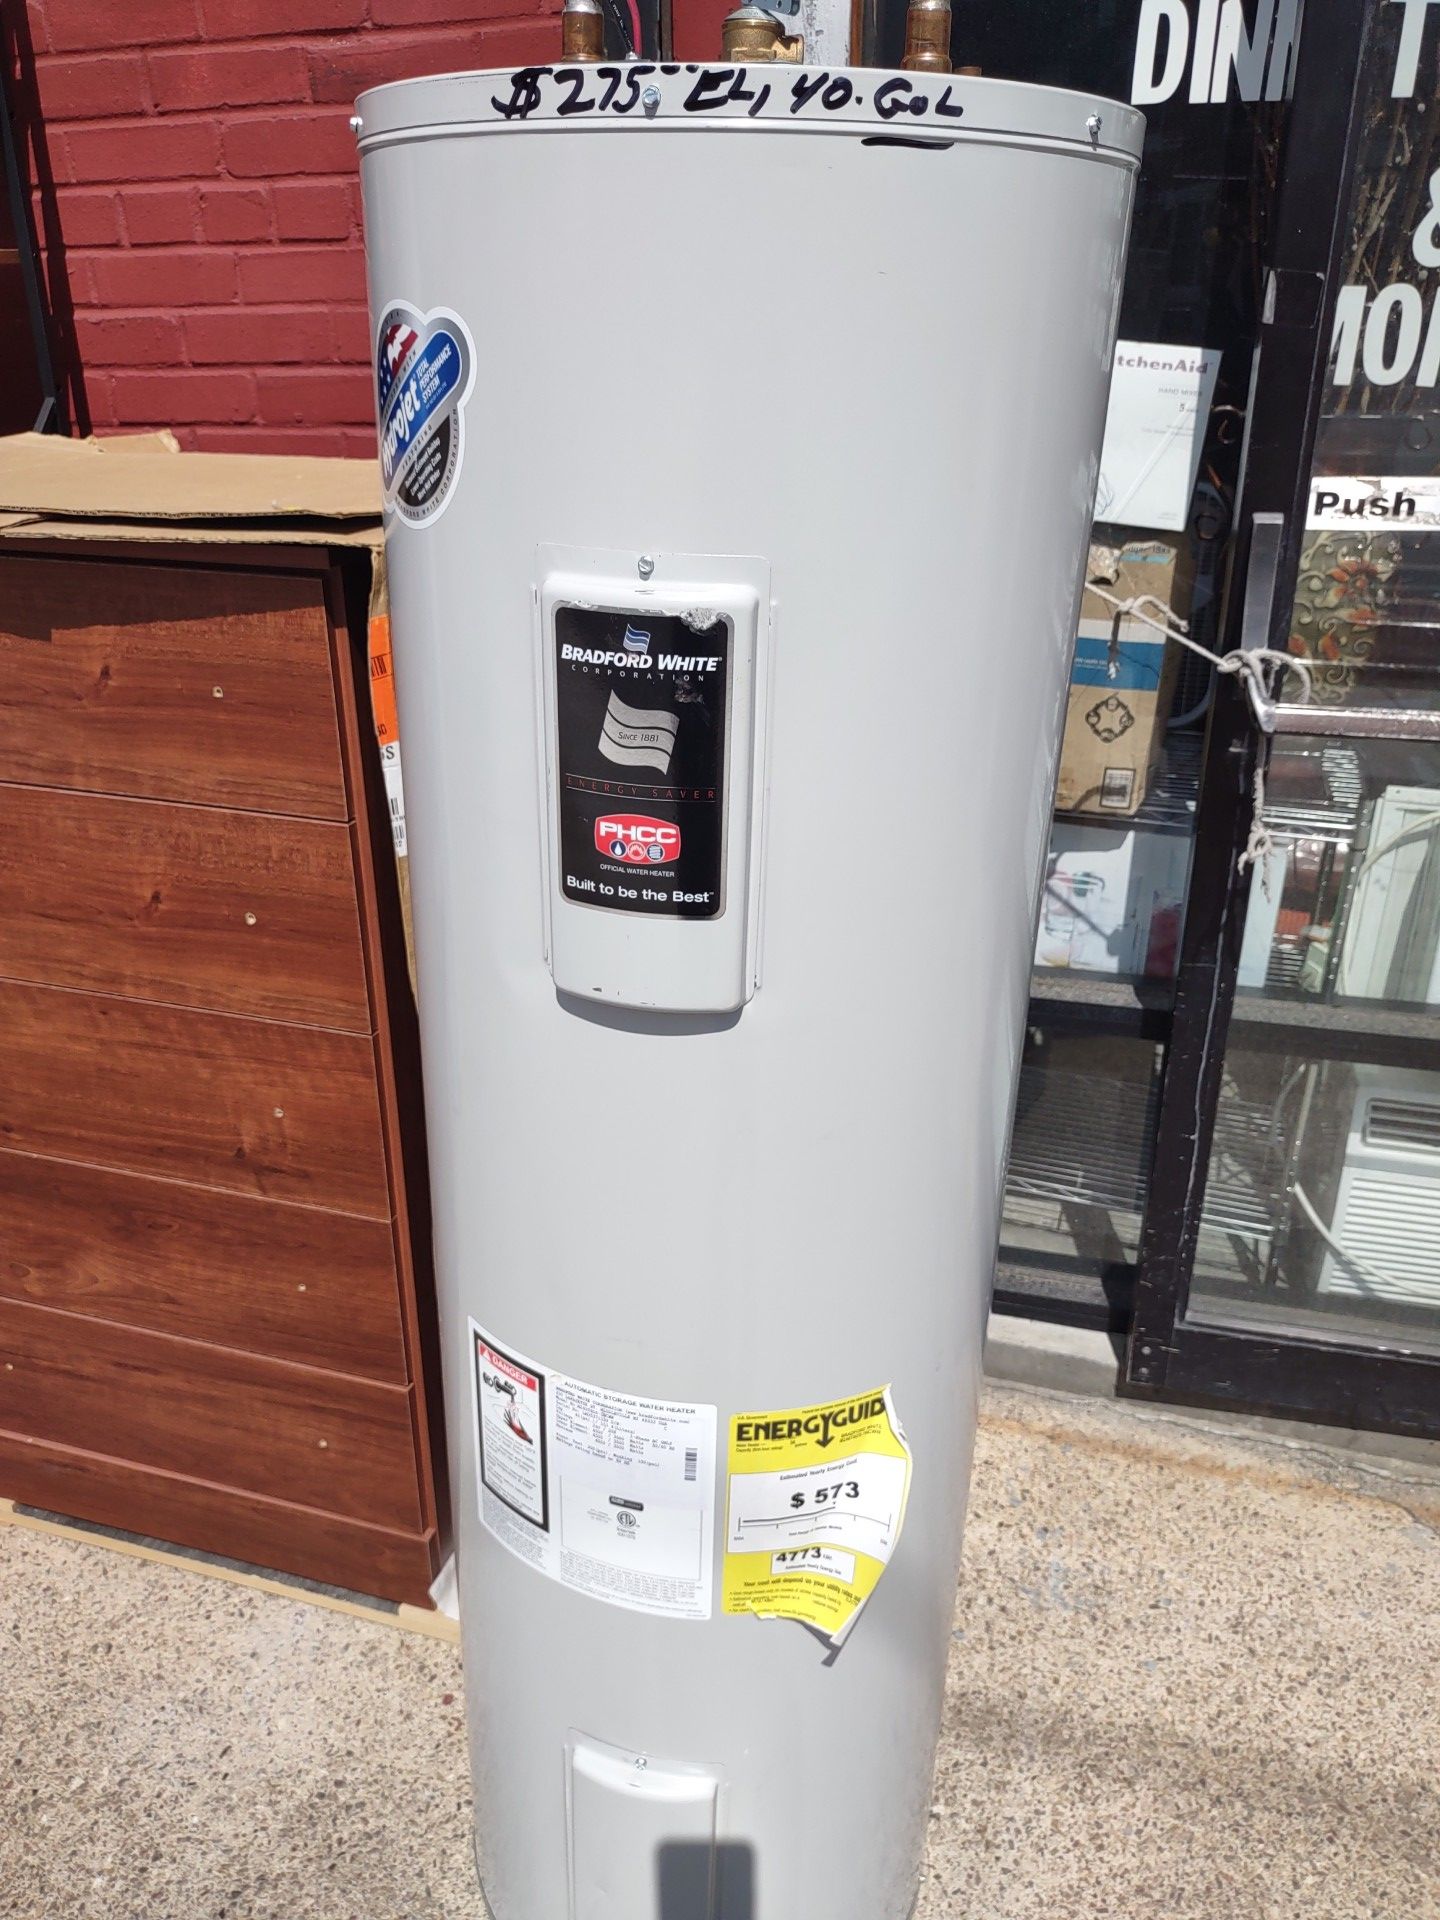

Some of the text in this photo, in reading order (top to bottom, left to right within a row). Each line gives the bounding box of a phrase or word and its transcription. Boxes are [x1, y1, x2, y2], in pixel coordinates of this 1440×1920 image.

[1314, 491, 1417, 518] Push
[561, 643, 719, 672] BRADFORD WHITE
[571, 664, 704, 682] CORPORATION
[640, 733, 660, 743] 1881
[567, 776, 715, 799] ENERGY SAVER
[600, 821, 677, 844] PHCC
[600, 863, 675, 878] OFFICIAL WATER HEATER
[566, 875, 710, 903] Built to be the Best
[564, 1381, 696, 1415] AUTOMATIC STORAGE WATER HEATER
[814, 1481, 860, 1504] 573
[775, 1546, 822, 1562] 4773
